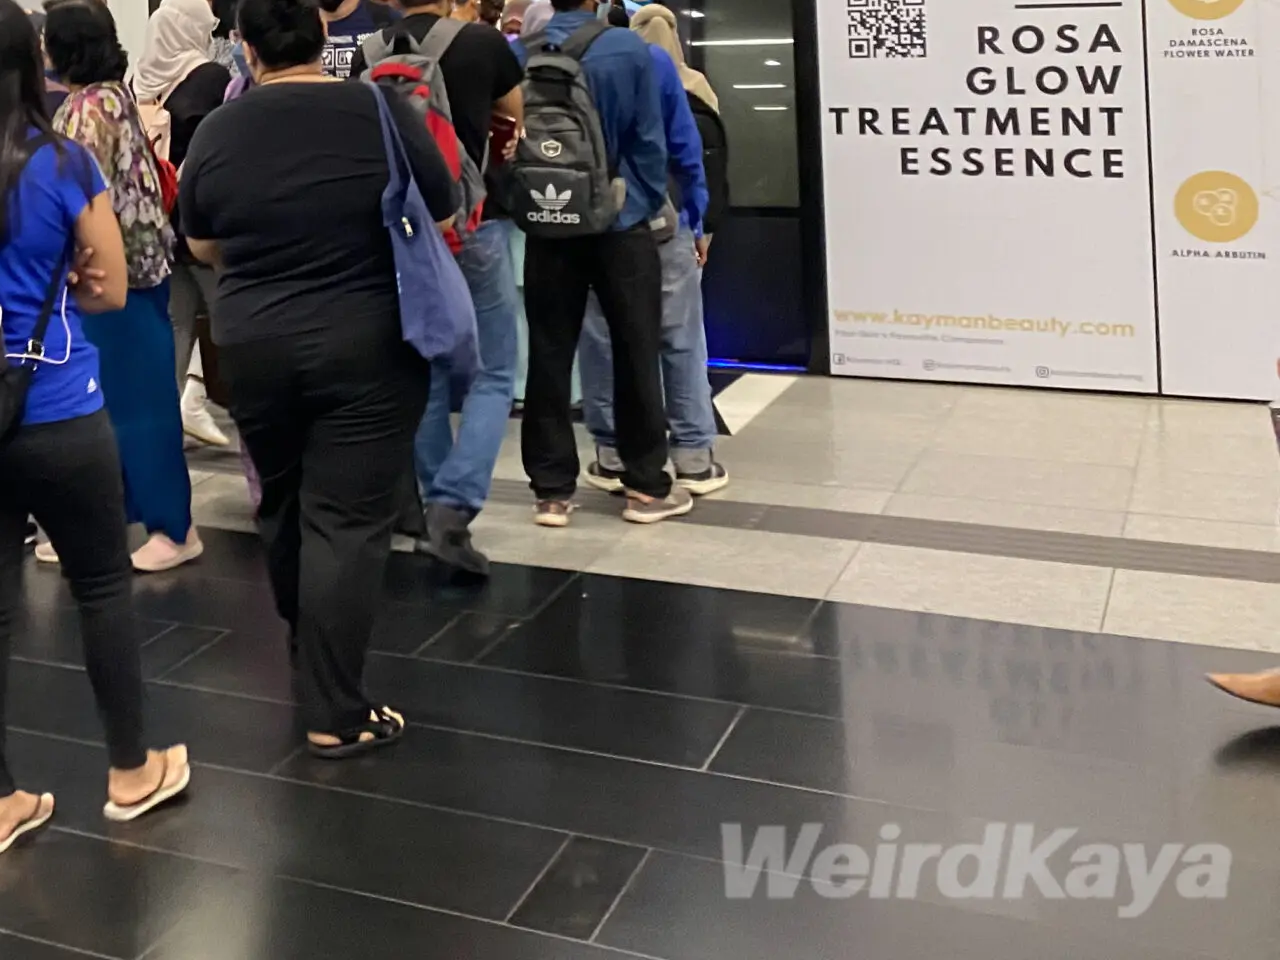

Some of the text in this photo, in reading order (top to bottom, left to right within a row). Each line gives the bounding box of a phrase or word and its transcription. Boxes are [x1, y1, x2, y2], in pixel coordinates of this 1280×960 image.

[977, 23, 1122, 55] ROSA
[1169, 38, 1248, 47] DAMASCENA
[1191, 27, 1224, 36] ROSA
[1163, 48, 1255, 58] FLOWER WATER
[966, 64, 1122, 96] GLOW
[828, 106, 1124, 136] TREATMENT
[900, 146, 1124, 178] ESSENCE
[526, 209, 581, 224] adidas
[1171, 249, 1267, 260] ALPHA ARBUTIN
[833, 308, 1136, 338] www.kaymanbeauty.com
